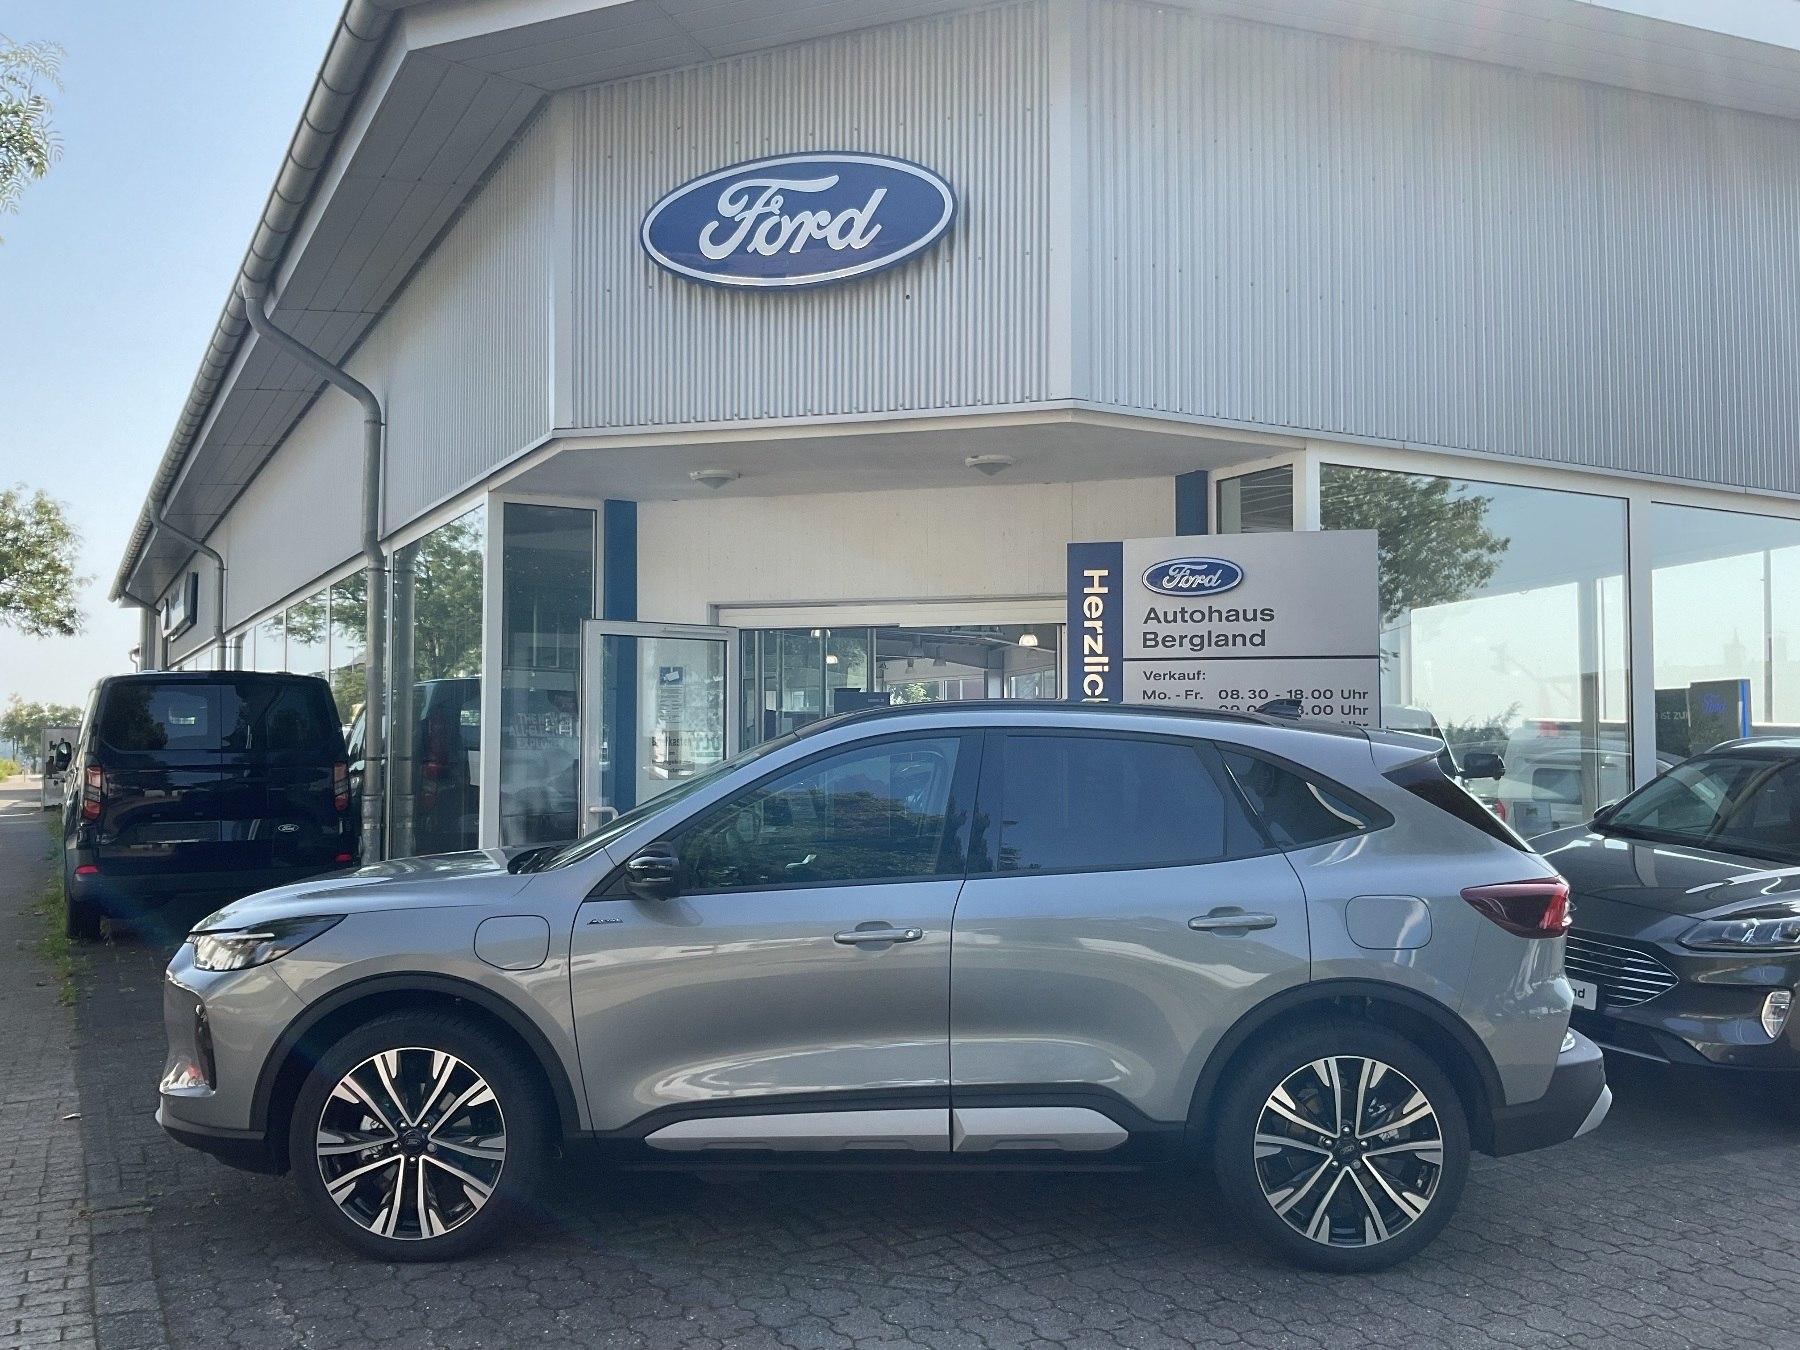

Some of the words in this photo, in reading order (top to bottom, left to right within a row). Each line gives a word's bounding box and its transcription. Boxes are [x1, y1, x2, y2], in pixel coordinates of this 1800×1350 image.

[699, 174, 888, 260] Ford
[1162, 564, 1223, 589] Ford
[1142, 605, 1275, 625] Autohaus
[1142, 629, 1266, 652] Bergland
[1142, 670, 1206, 681] Verkauf:
[1142, 689, 1172, 700] Mo.
[1184, 689, 1204, 700] Fr.
[1340, 688, 1369, 700] Uhr
[1340, 704, 1369, 716] Uhr
